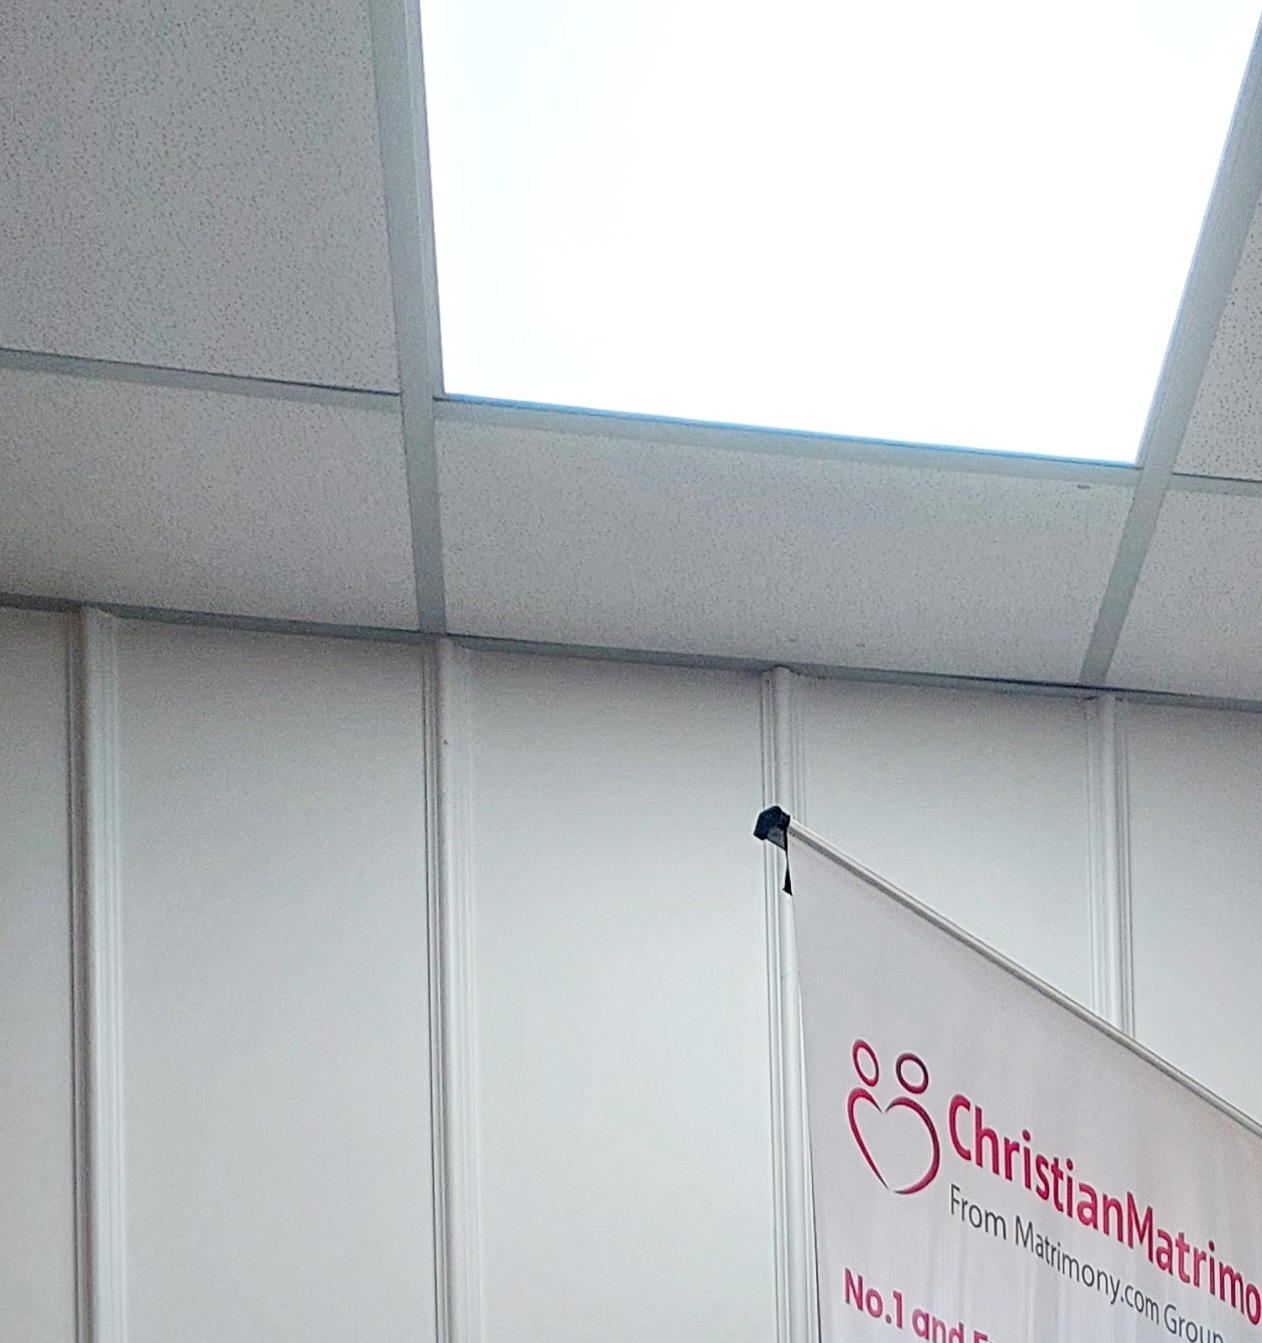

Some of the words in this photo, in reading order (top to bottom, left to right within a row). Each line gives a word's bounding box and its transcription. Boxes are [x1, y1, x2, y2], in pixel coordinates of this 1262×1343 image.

[844, 1267, 904, 1330] No.1
[949, 1184, 1008, 1241] From
[1015, 1215, 1160, 1328] Matrimony.com
